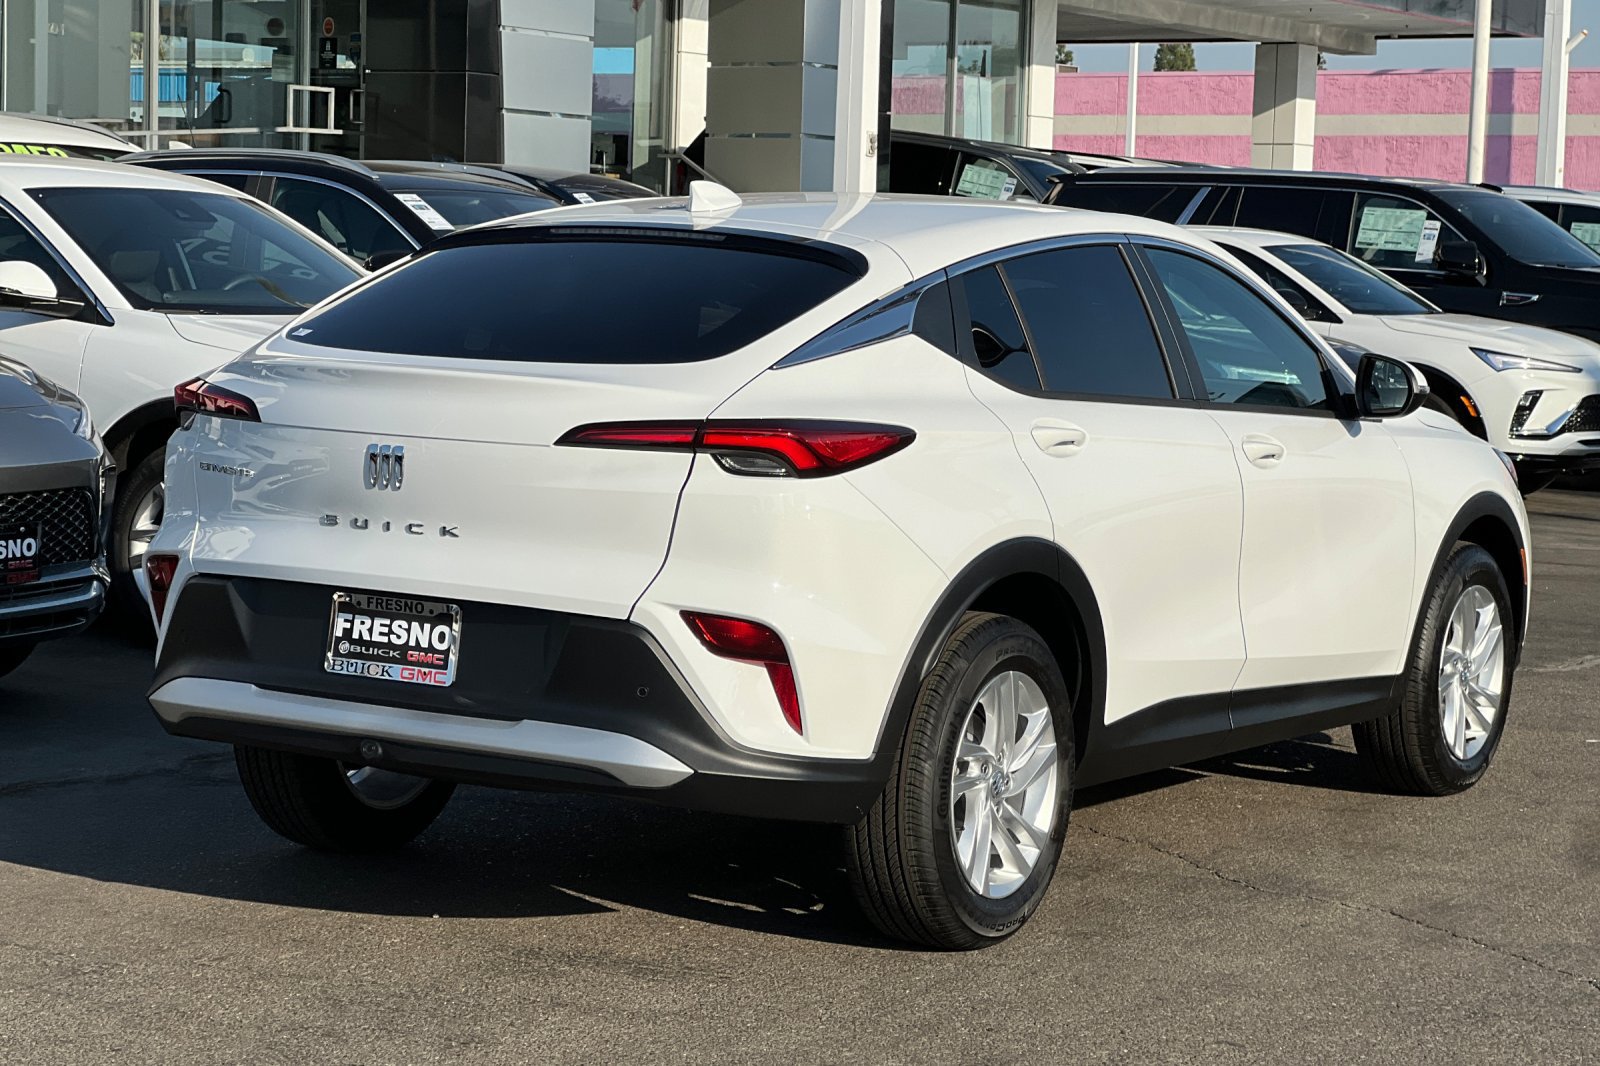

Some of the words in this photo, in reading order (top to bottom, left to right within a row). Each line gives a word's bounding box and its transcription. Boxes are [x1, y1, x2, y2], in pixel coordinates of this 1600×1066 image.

[320, 514, 459, 538] BUICK
[367, 597, 425, 614] FRESNO
[335, 613, 451, 651] FRESNO
[349, 645, 401, 658] BUICK
[407, 650, 445, 665] GMC
[330, 658, 394, 678] BUICK
[400, 667, 448, 685] GMC
